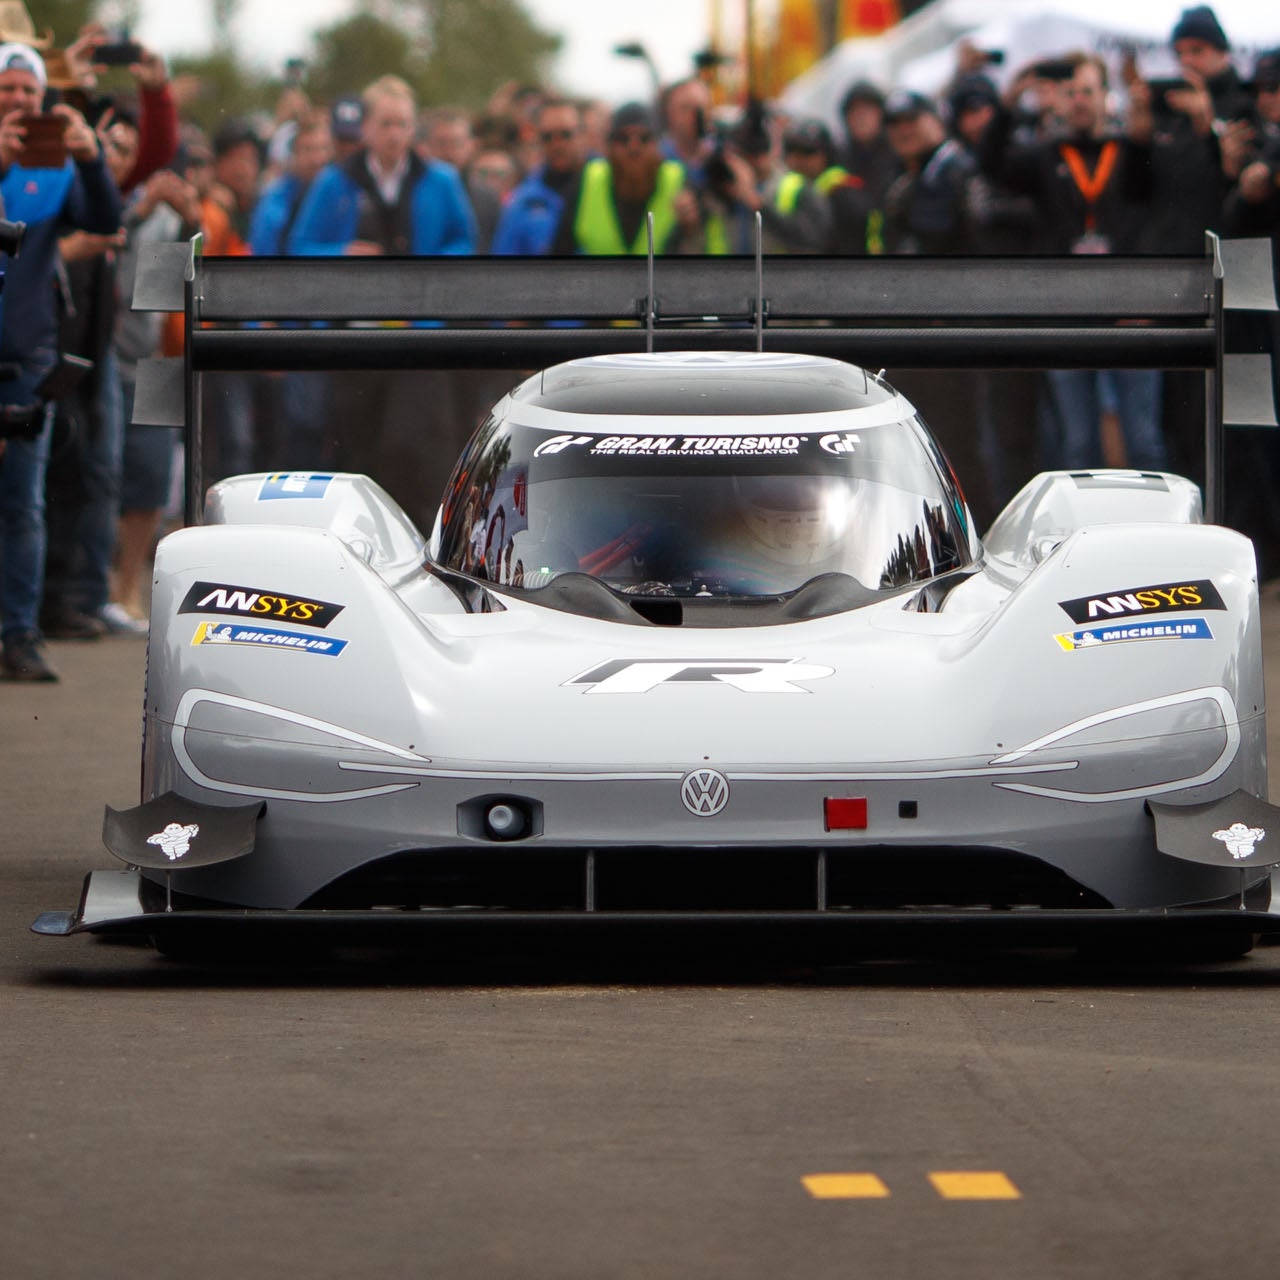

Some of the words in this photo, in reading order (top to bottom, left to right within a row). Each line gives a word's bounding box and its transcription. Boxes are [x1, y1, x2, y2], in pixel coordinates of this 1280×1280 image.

[595, 435, 679, 450] GRAN
[683, 435, 802, 450] TURISMO
[589, 448, 618, 456] THE
[617, 448, 655, 456] REAL
[657, 448, 715, 456] DRIVING
[717, 448, 799, 456] SIMULATOR
[197, 588, 319, 620] ANSYS
[1088, 585, 1203, 617] ANSYS
[234, 631, 333, 651] MICHELIN
[1102, 624, 1197, 641] MICHELIN
